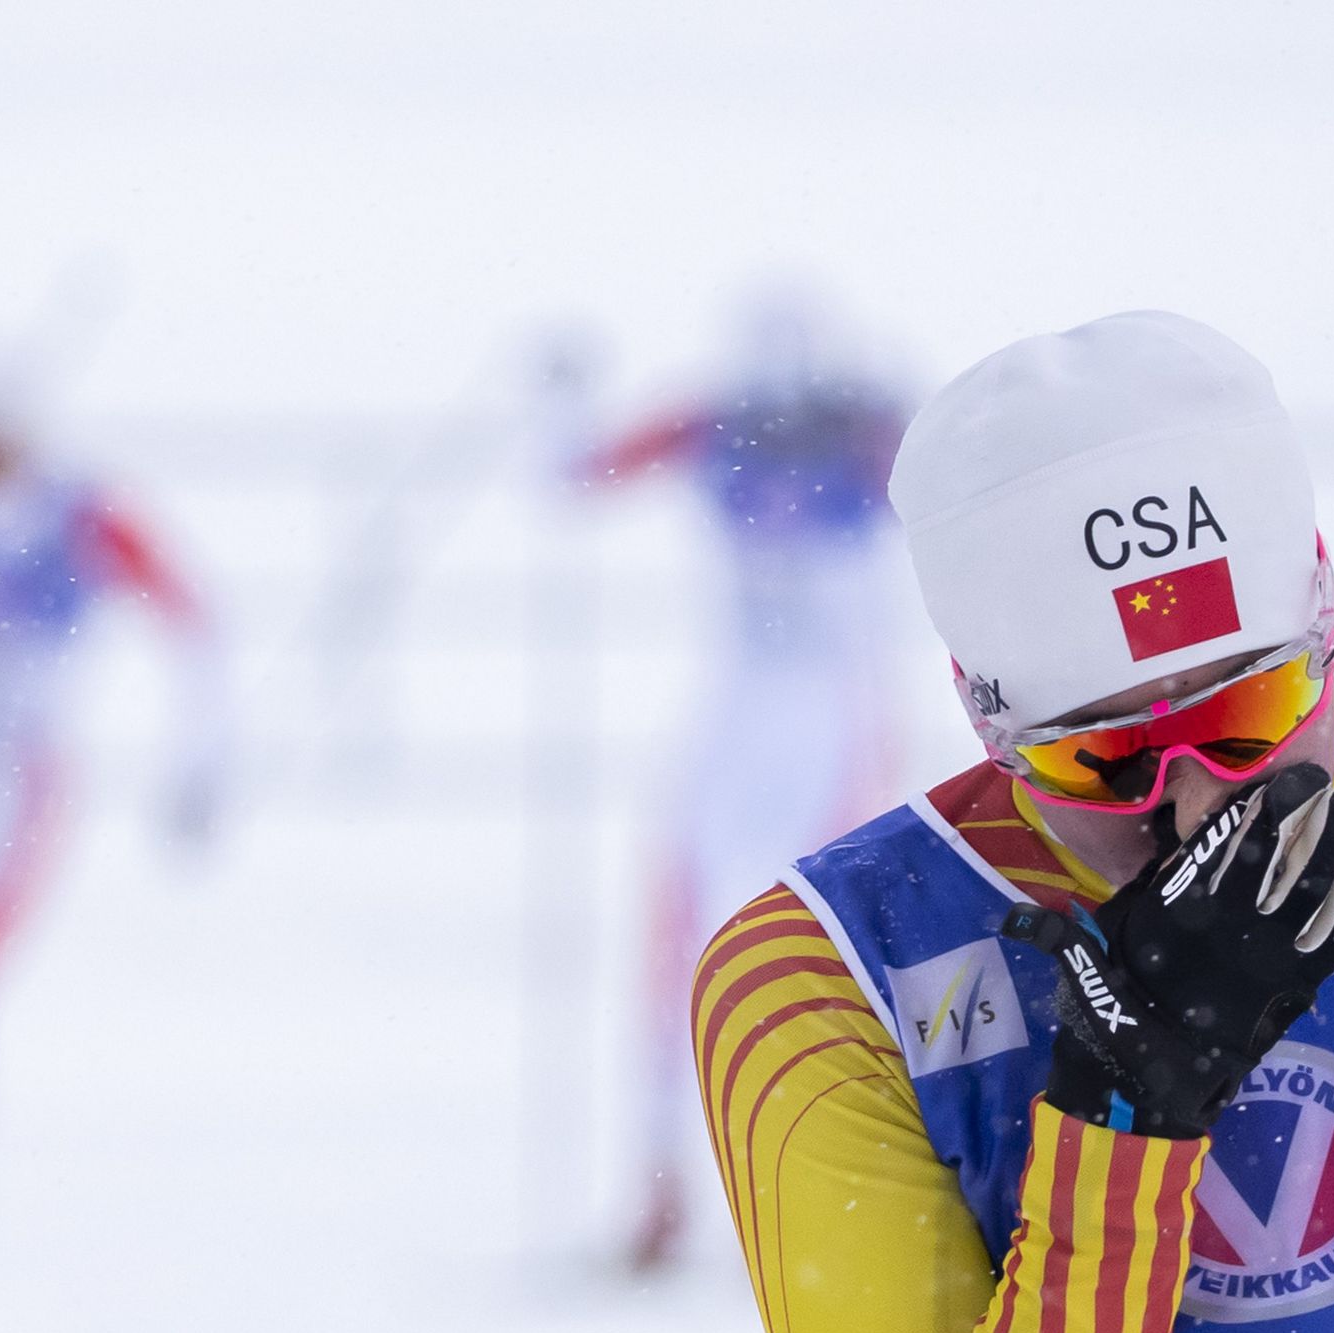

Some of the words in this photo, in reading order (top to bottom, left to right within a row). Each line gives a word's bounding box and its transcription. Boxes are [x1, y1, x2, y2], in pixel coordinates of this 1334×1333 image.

[1083, 485, 1228, 572] CSA
[1161, 800, 1249, 906] SWI
[1063, 943, 1138, 1034] SWIX
